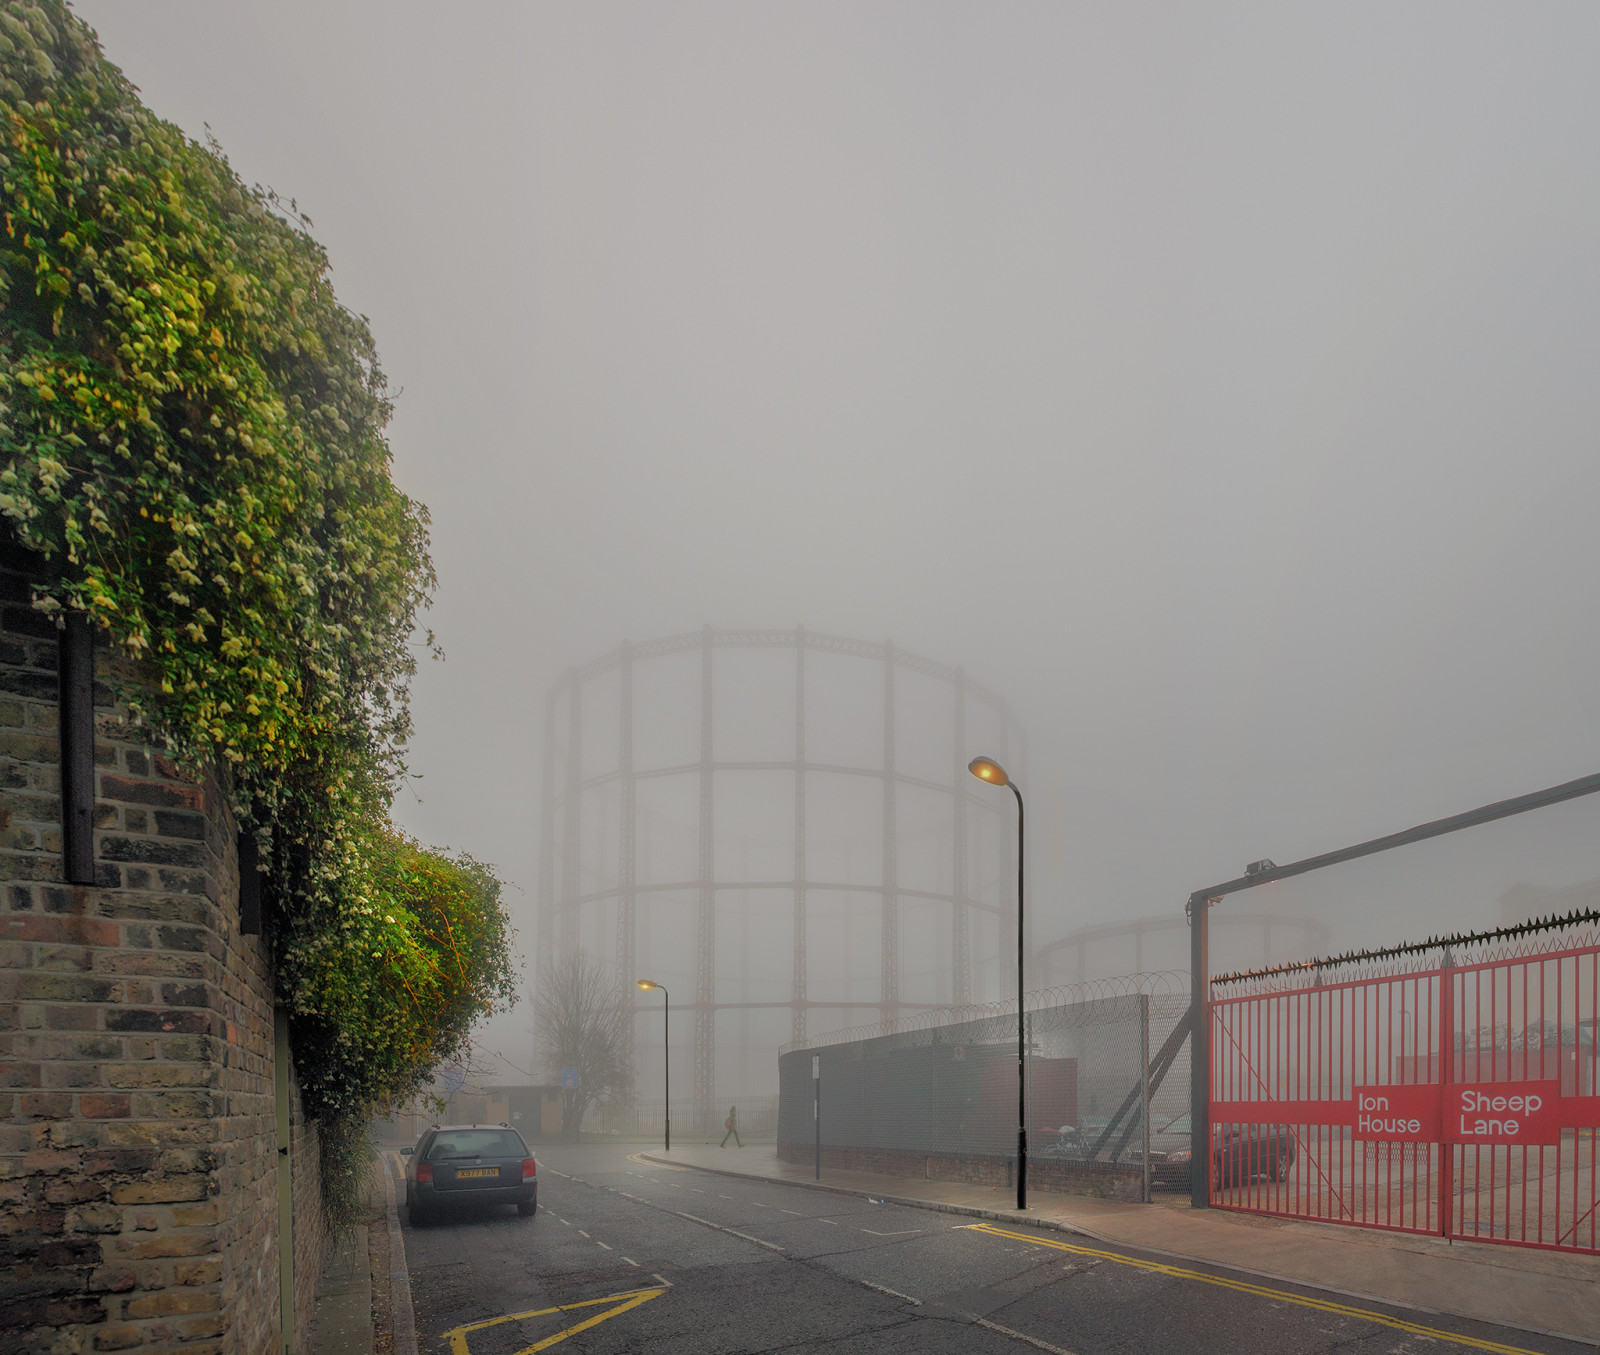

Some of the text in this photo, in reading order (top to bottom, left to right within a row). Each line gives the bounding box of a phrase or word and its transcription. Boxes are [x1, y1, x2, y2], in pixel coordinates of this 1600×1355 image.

[1358, 1093, 1389, 1111] Ion
[1461, 1090, 1542, 1117] Sheep
[1358, 1114, 1421, 1133] House
[1460, 1114, 1519, 1135] Lane
